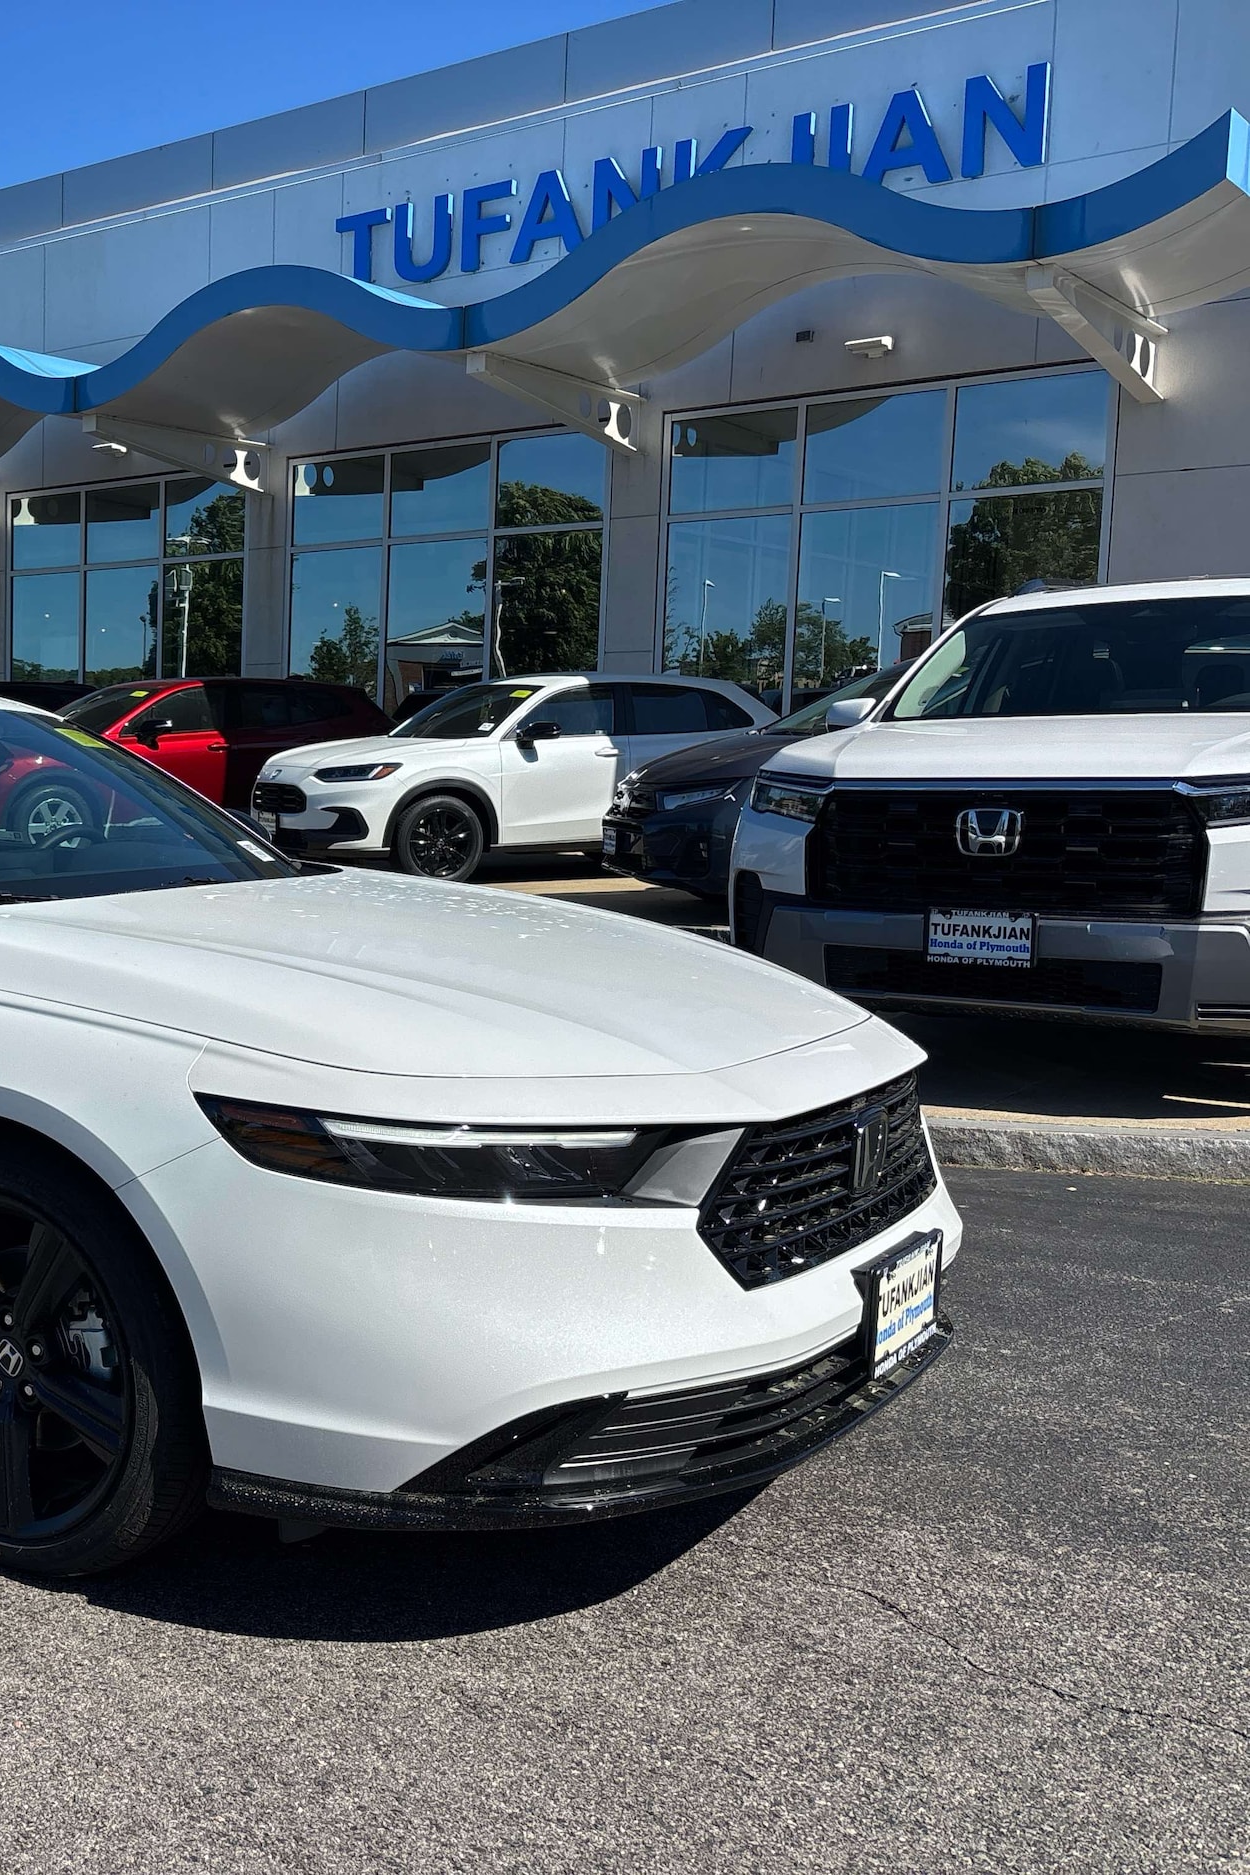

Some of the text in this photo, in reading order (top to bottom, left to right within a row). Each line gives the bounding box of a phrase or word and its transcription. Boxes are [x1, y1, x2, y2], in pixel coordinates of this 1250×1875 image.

[951, 909, 1010, 919] TUFANKJIAN
[931, 922, 1030, 941] TUFANKJIAN
[930, 938, 1030, 953] Honda of Plymouth
[927, 955, 1031, 968] HONDA OF PLYMOUTH
[876, 1319, 896, 1346] onda
